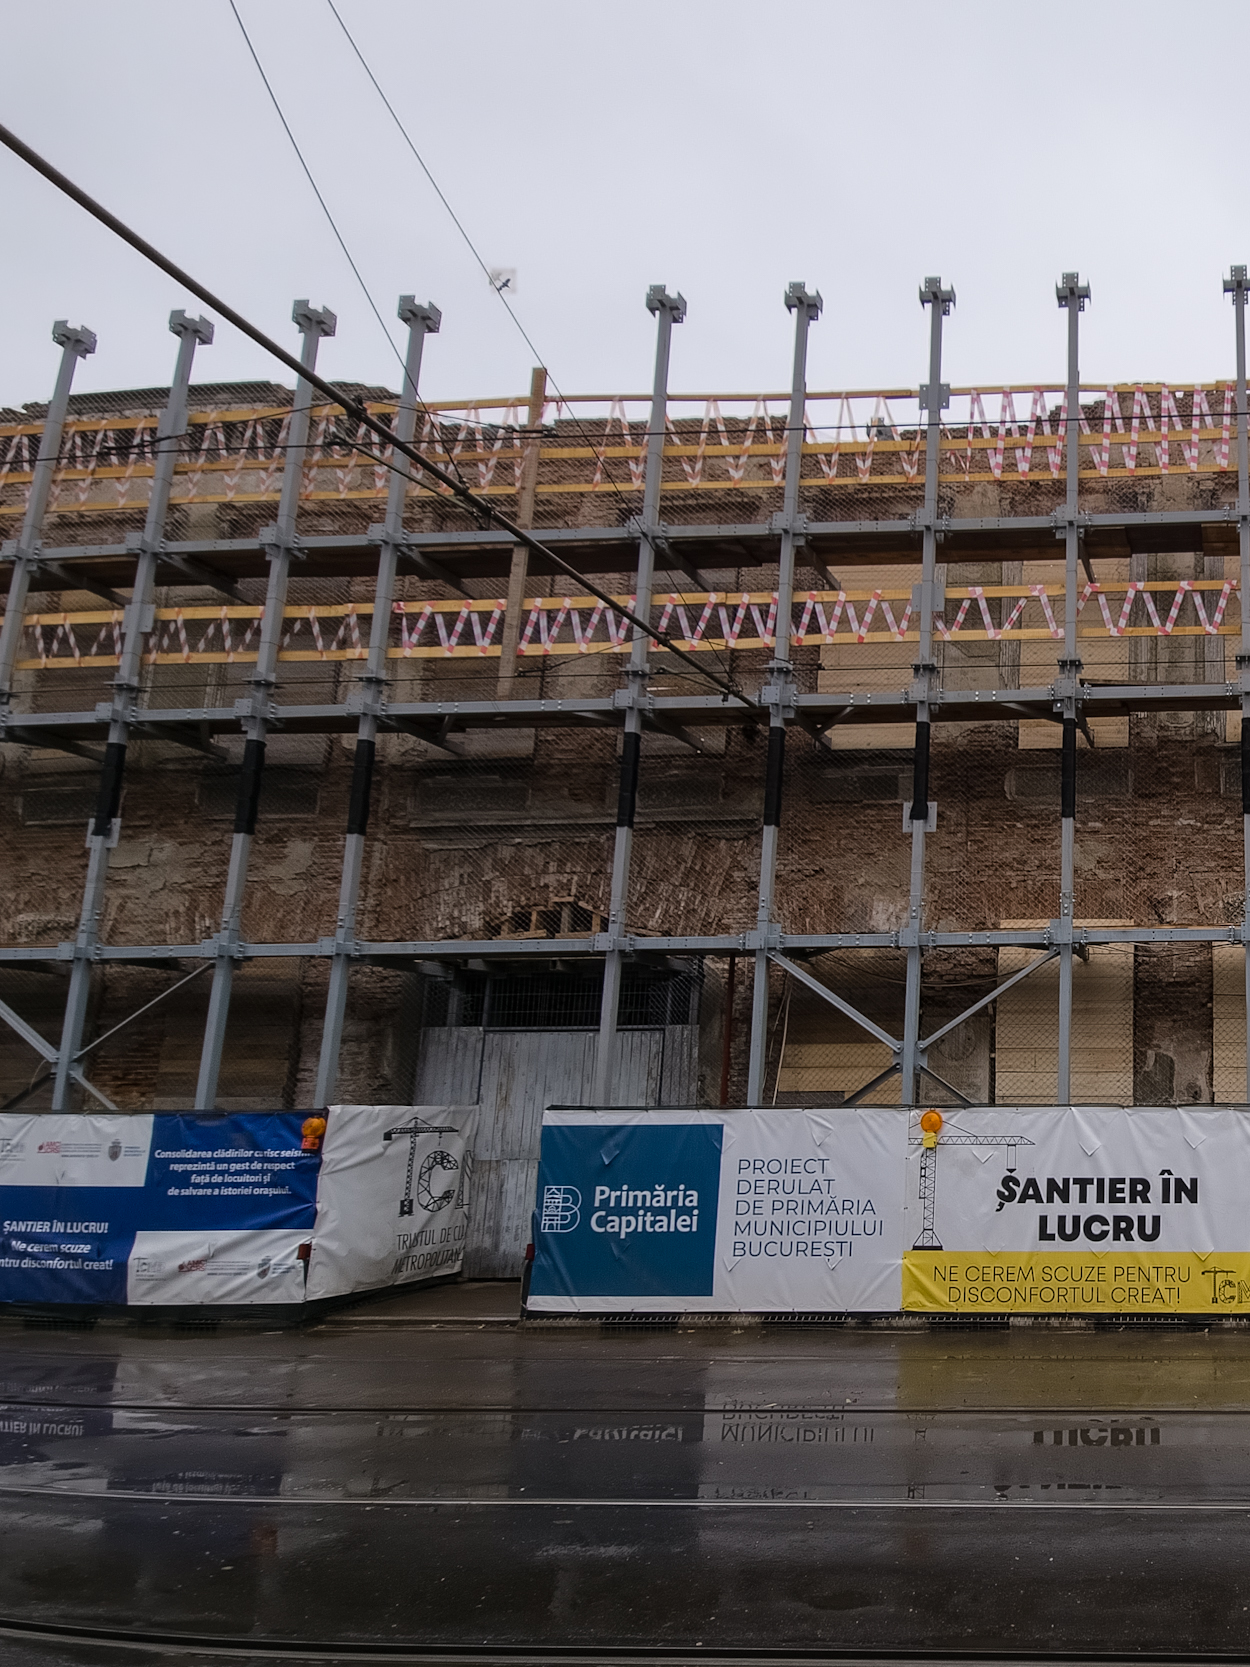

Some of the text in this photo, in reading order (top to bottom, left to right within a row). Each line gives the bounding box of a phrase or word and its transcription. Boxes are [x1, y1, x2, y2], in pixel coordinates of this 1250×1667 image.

[154, 1149, 212, 1159] Consolidarea
[213, 1149, 253, 1158] clădirilor
[169, 1162, 215, 1172] reprezintă
[229, 1162, 249, 1172] gest
[250, 1161, 262, 1170] de
[738, 1158, 830, 1175] PROIECT
[211, 1174, 223, 1183] de
[224, 1174, 262, 1183] locuitori
[736, 1179, 836, 1195] DERULAT
[167, 1187, 180, 1196] de
[180, 1186, 212, 1196] salvare
[220, 1186, 251, 1195] istoriei
[594, 1184, 699, 1208] Primăria
[995, 1169, 1198, 1212] ȘANTIER ÎN
[735, 1195, 876, 1215] DE PRIMĂRIA
[3, 1220, 109, 1235] ȘANTIER ÎN LUCRU!
[590, 1208, 699, 1239] Capitalei
[734, 1219, 883, 1236] MUNICIPIULUI
[1038, 1214, 1161, 1242] LUCRU
[11, 1240, 91, 1253] Ne cerem scuze
[397, 1229, 437, 1251] TRUSTUL
[439, 1227, 452, 1244] DE
[732, 1241, 853, 1262] BUCUREȘTI
[20, 1257, 82, 1269] disconfortul
[83, 1259, 114, 1270] creat!
[933, 1265, 1191, 1283] NE CEREM SCUZE PENTRU
[948, 1286, 1181, 1304] DISCONFORTUL CREAT!
